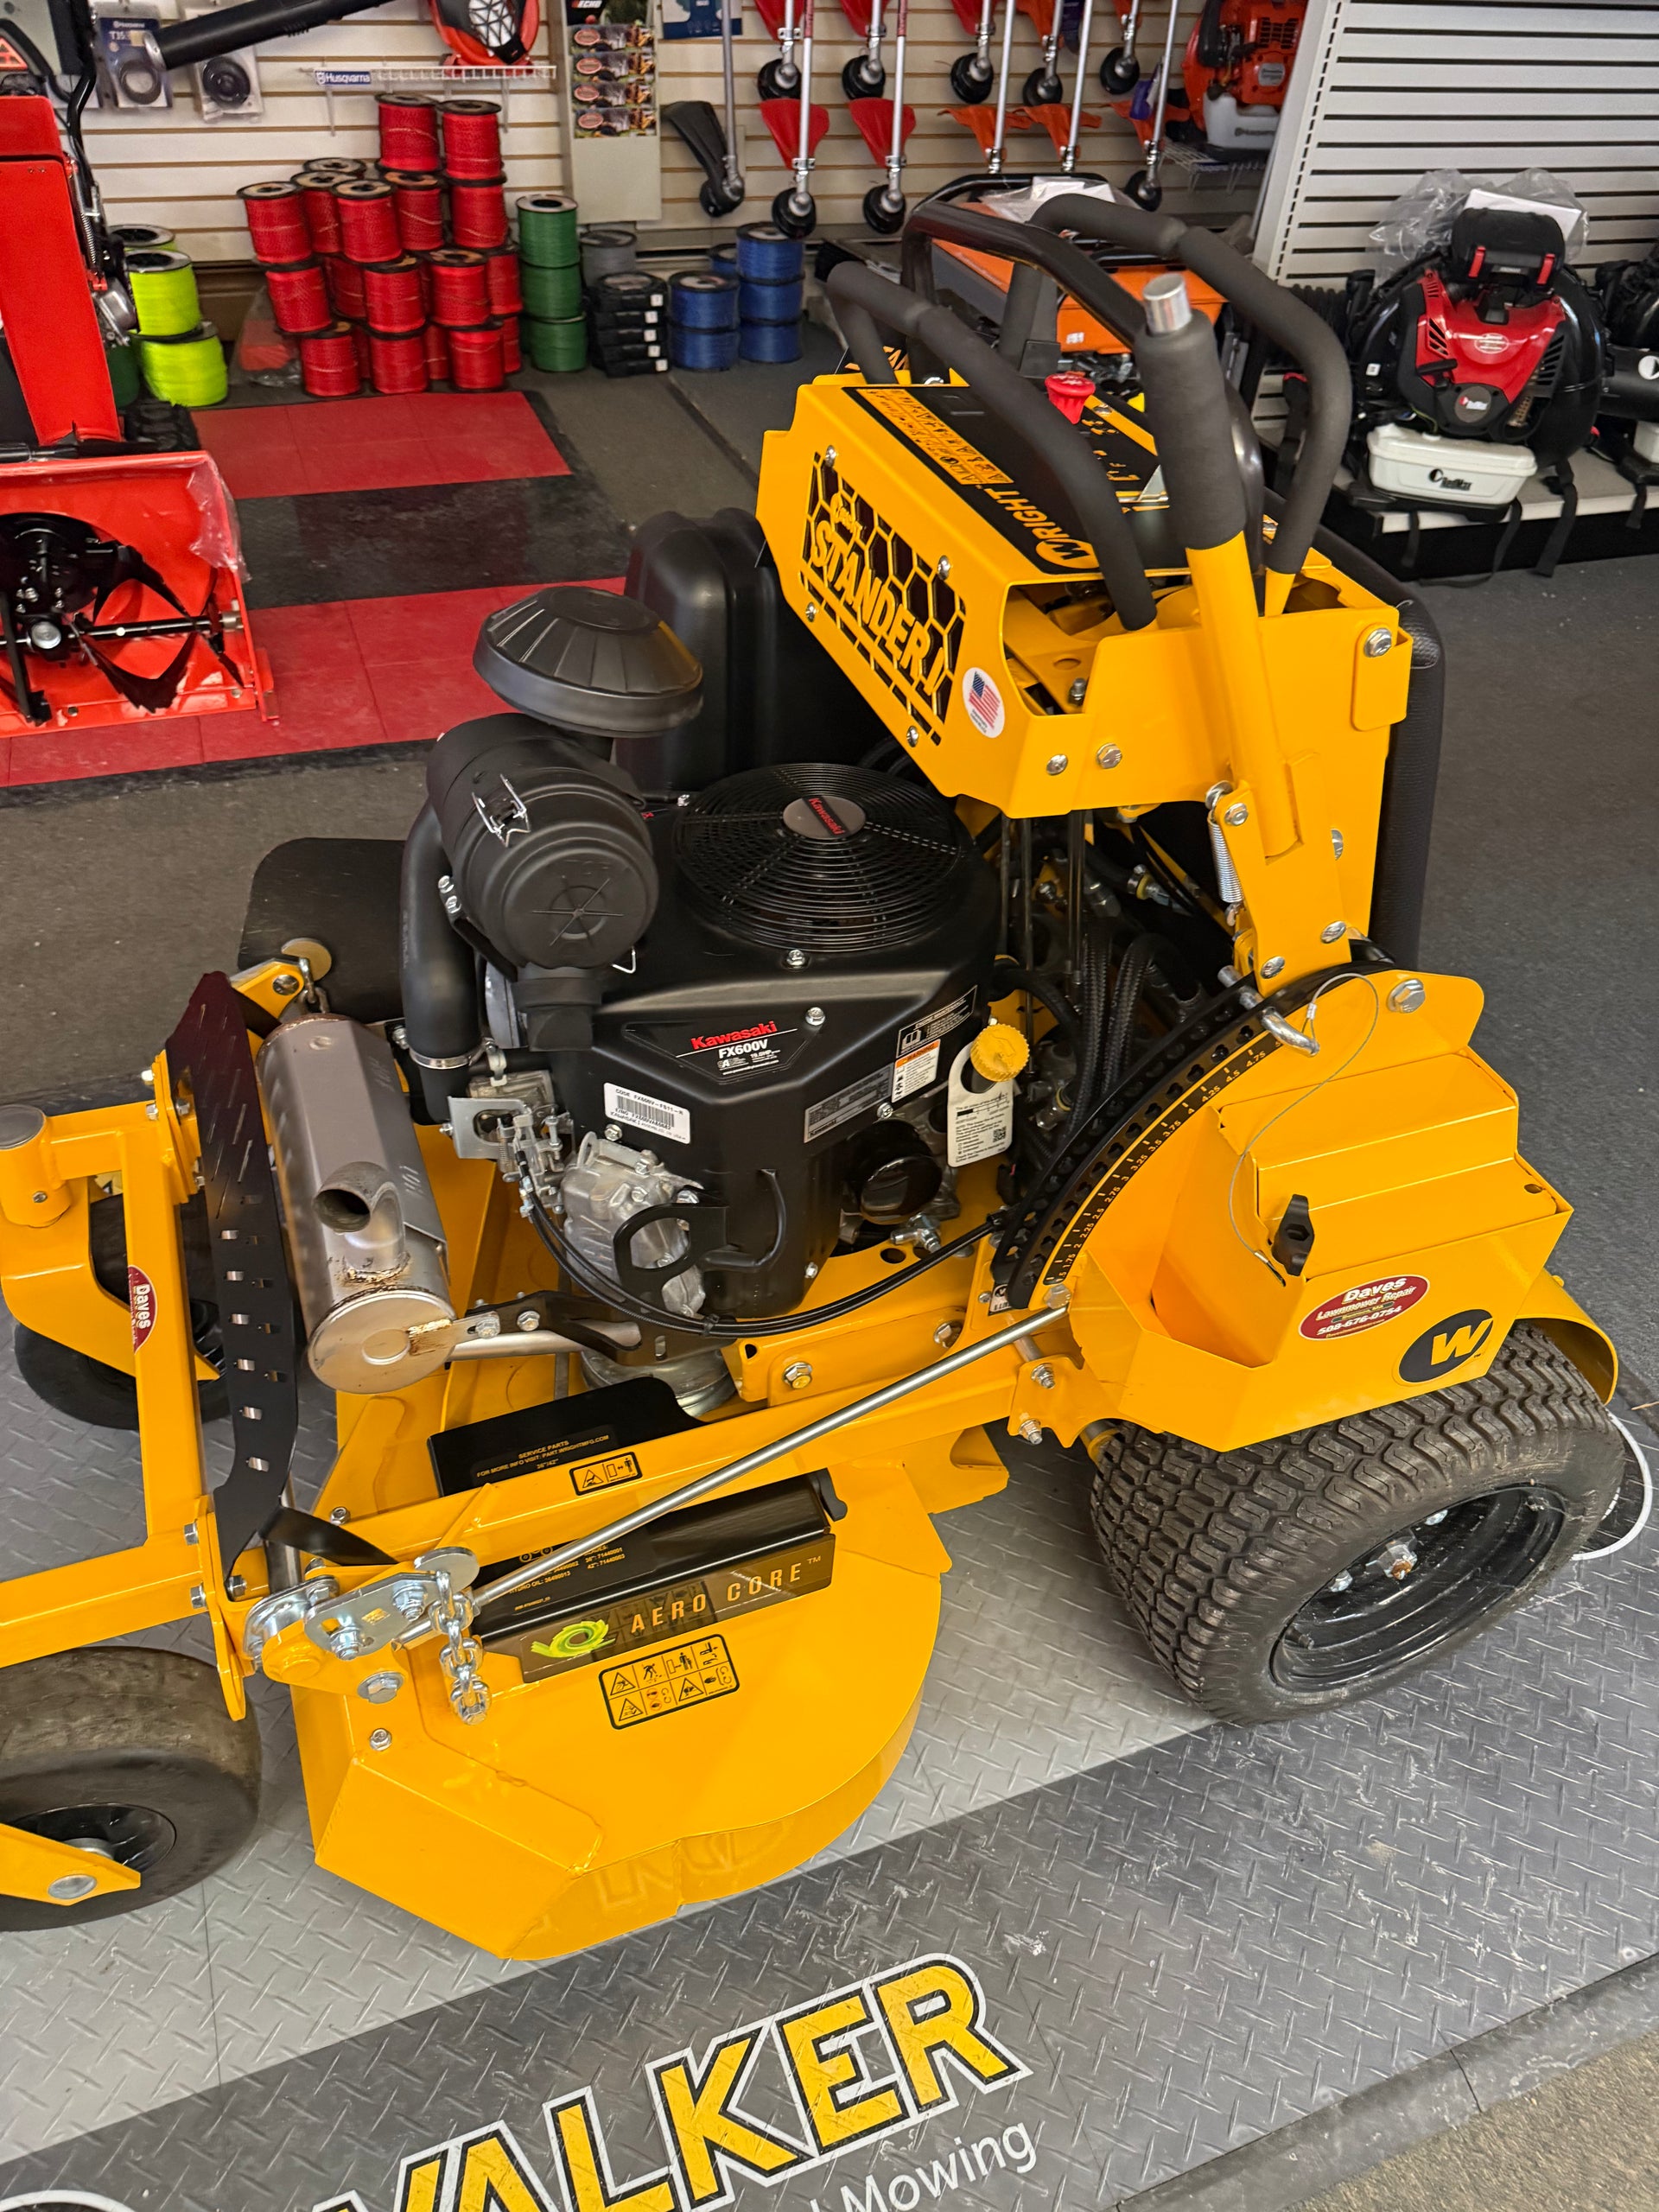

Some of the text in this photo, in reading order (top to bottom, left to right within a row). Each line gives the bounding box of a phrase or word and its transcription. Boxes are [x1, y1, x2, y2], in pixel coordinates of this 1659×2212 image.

[325, 71, 371, 85] Husqvarna
[810, 519, 931, 671] STANDER
[808, 797, 846, 836] Kawasaki
[690, 1020, 779, 1051] Kawasaki
[718, 1039, 769, 1059] FX600V
[1245, 1051, 1267, 1068] 4.75
[1225, 1069, 1241, 1083] 4.5
[1201, 1085, 1221, 1103] 4.25
[1162, 1120, 1182, 1137] 3.75
[1147, 1139, 1163, 1152] 3.5
[1130, 1154, 1148, 1172] 3.25
[1104, 1186, 1121, 1203] 2.75
[1091, 1208, 1105, 1220] 2.5
[1079, 1223, 1095, 1238] 2.25
[1062, 1253, 1076, 1268] 1.75
[1342, 1277, 1408, 1305] Daves
[137, 1284, 151, 1329] Daves
[1315, 1296, 1382, 1321] Lawnmower
[1380, 1286, 1417, 1303] Repair
[1317, 1306, 1403, 1336] 508-676-0754
[518, 1440, 569, 1459] SERVICE PARTS
[477, 1469, 490, 1478] FOR
[490, 1464, 510, 1474] MORE
[510, 1459, 524, 1469] INFO
[631, 1593, 707, 1633] AERO
[727, 1562, 803, 1601] CORE
[840, 2122, 1037, 2212] Mowing
